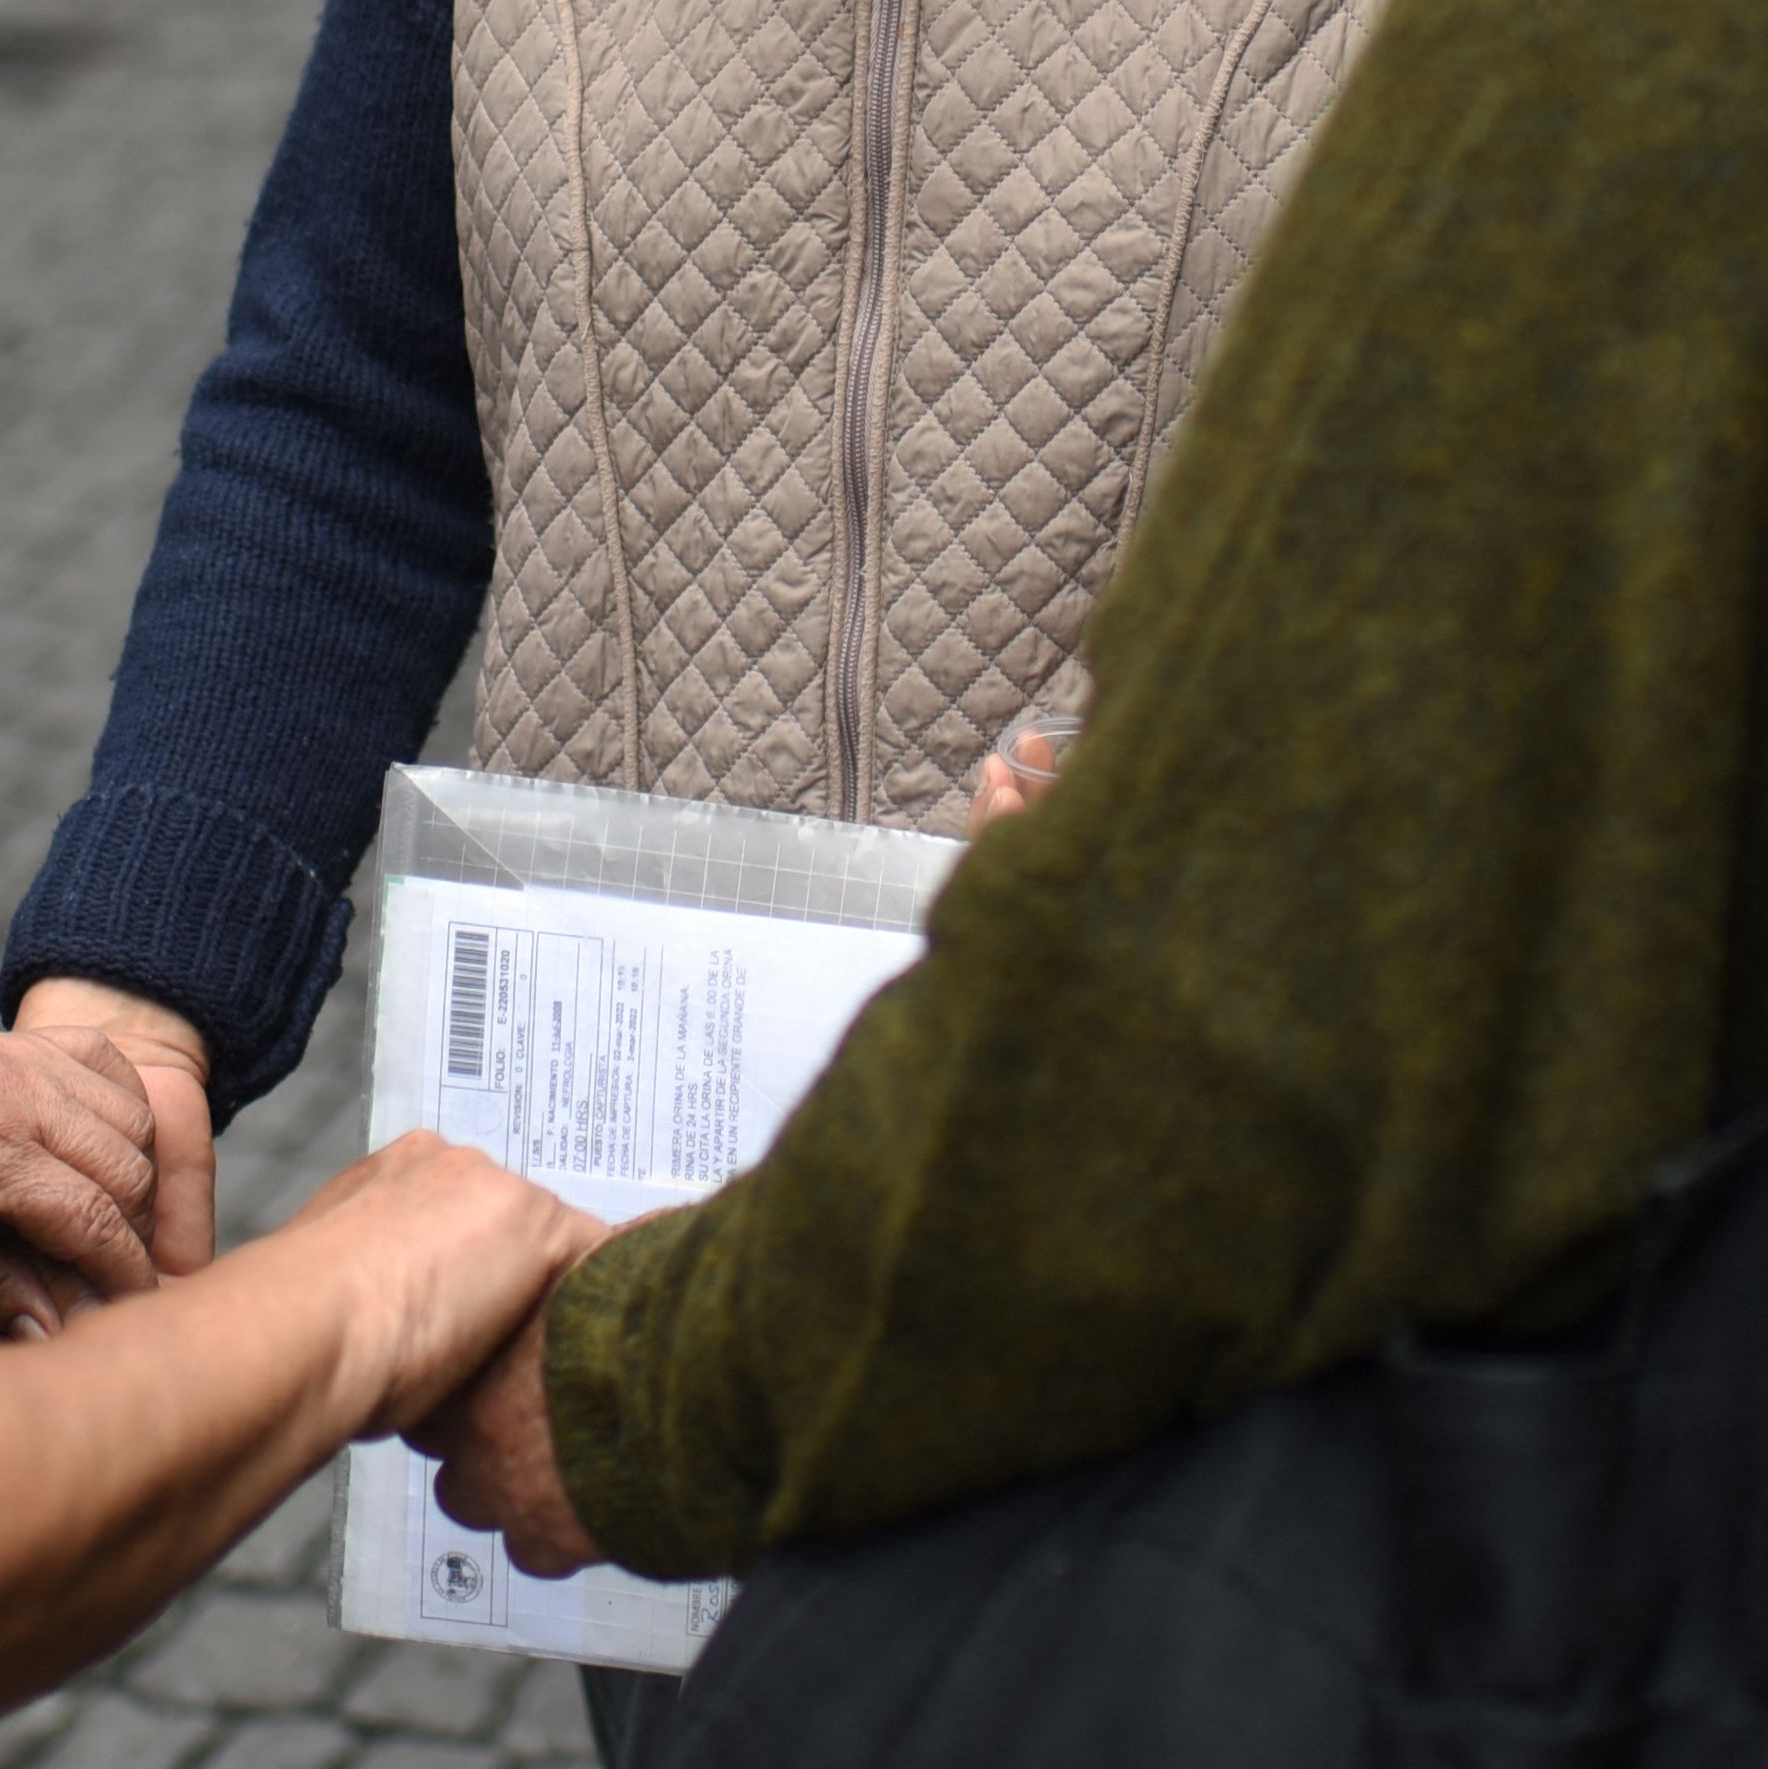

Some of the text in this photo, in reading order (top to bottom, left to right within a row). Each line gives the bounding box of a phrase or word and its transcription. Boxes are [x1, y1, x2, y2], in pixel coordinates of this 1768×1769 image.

[709, 950, 719, 965] LA
[707, 969, 718, 986] DE
[722, 949, 732, 989] ORINA
[736, 968, 747, 985] DE
[494, 950, 510, 1089] FOLIO: E-220531020
[717, 993, 730, 1055] SEGUNDA
[732, 989, 745, 1043] GRANDE
[516, 1024, 525, 1059] CLAVE:
[704, 1023, 715, 1045] LAS
[676, 1045, 686, 1059] LA
[703, 1050, 713, 1066] DE
[562, 1041, 572, 1107] NEFROLOGIA
[675, 1064, 685, 1080] DE
[717, 1059, 727, 1074] LA
[548, 1059, 559, 1123] NACIMIENTO
[596, 1055, 606, 1120] CAPTURISTA
[701, 1071, 712, 1110] ORINA
[716, 1078, 726, 1095] DE
[729, 1048, 742, 1121] RECIPIENTE
[673, 1085, 683, 1124] ORINA
[688, 1083, 698, 1109] HRS
[687, 1114, 697, 1127] 24
[701, 1115, 711, 1129] LA
[714, 1099, 725, 1152] APARTIR
[609, 1127, 616, 1140] DE
[622, 1127, 631, 1139] DE
[686, 1131, 696, 1147] DE
[728, 1126, 738, 1143] UN
[699, 1133, 710, 1161] CITA
[727, 1147, 737, 1165] EN
[607, 1143, 616, 1177] FECHA
[621, 1143, 630, 1177] FECHA
[699, 1164, 709, 1181] SU
[713, 1168, 722, 1183] LA
[691, 1587, 701, 1632] NOMBRE
